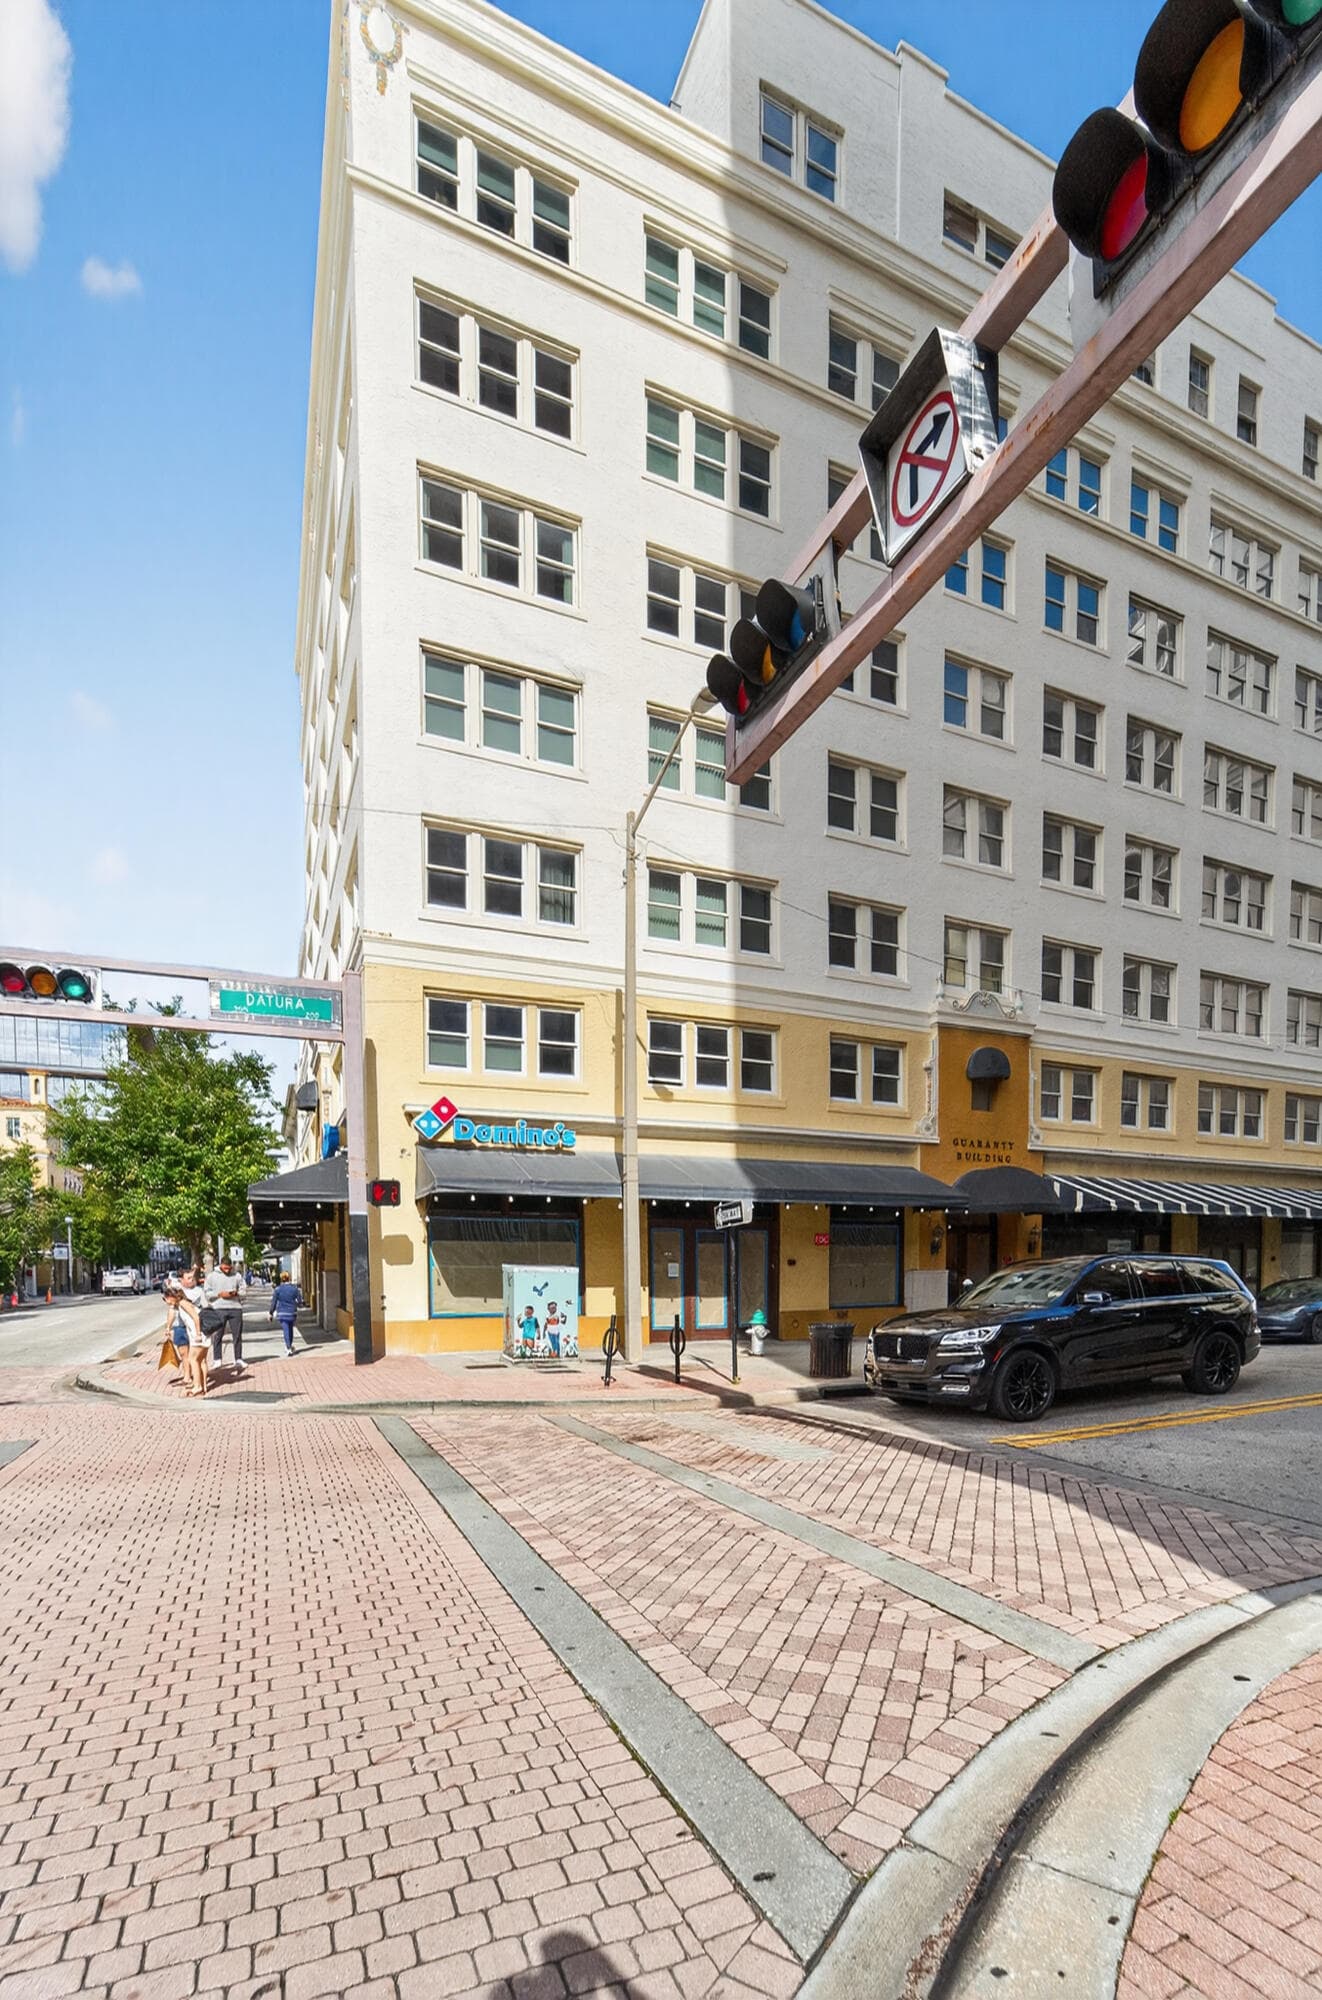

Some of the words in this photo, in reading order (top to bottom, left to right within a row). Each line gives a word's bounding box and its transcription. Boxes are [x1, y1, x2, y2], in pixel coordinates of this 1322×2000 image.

[246, 993, 305, 1011] DATURA
[453, 1117, 577, 1149] Domino's
[952, 1137, 1015, 1151] GUARANTY
[956, 1151, 1012, 1164] BUILDING
